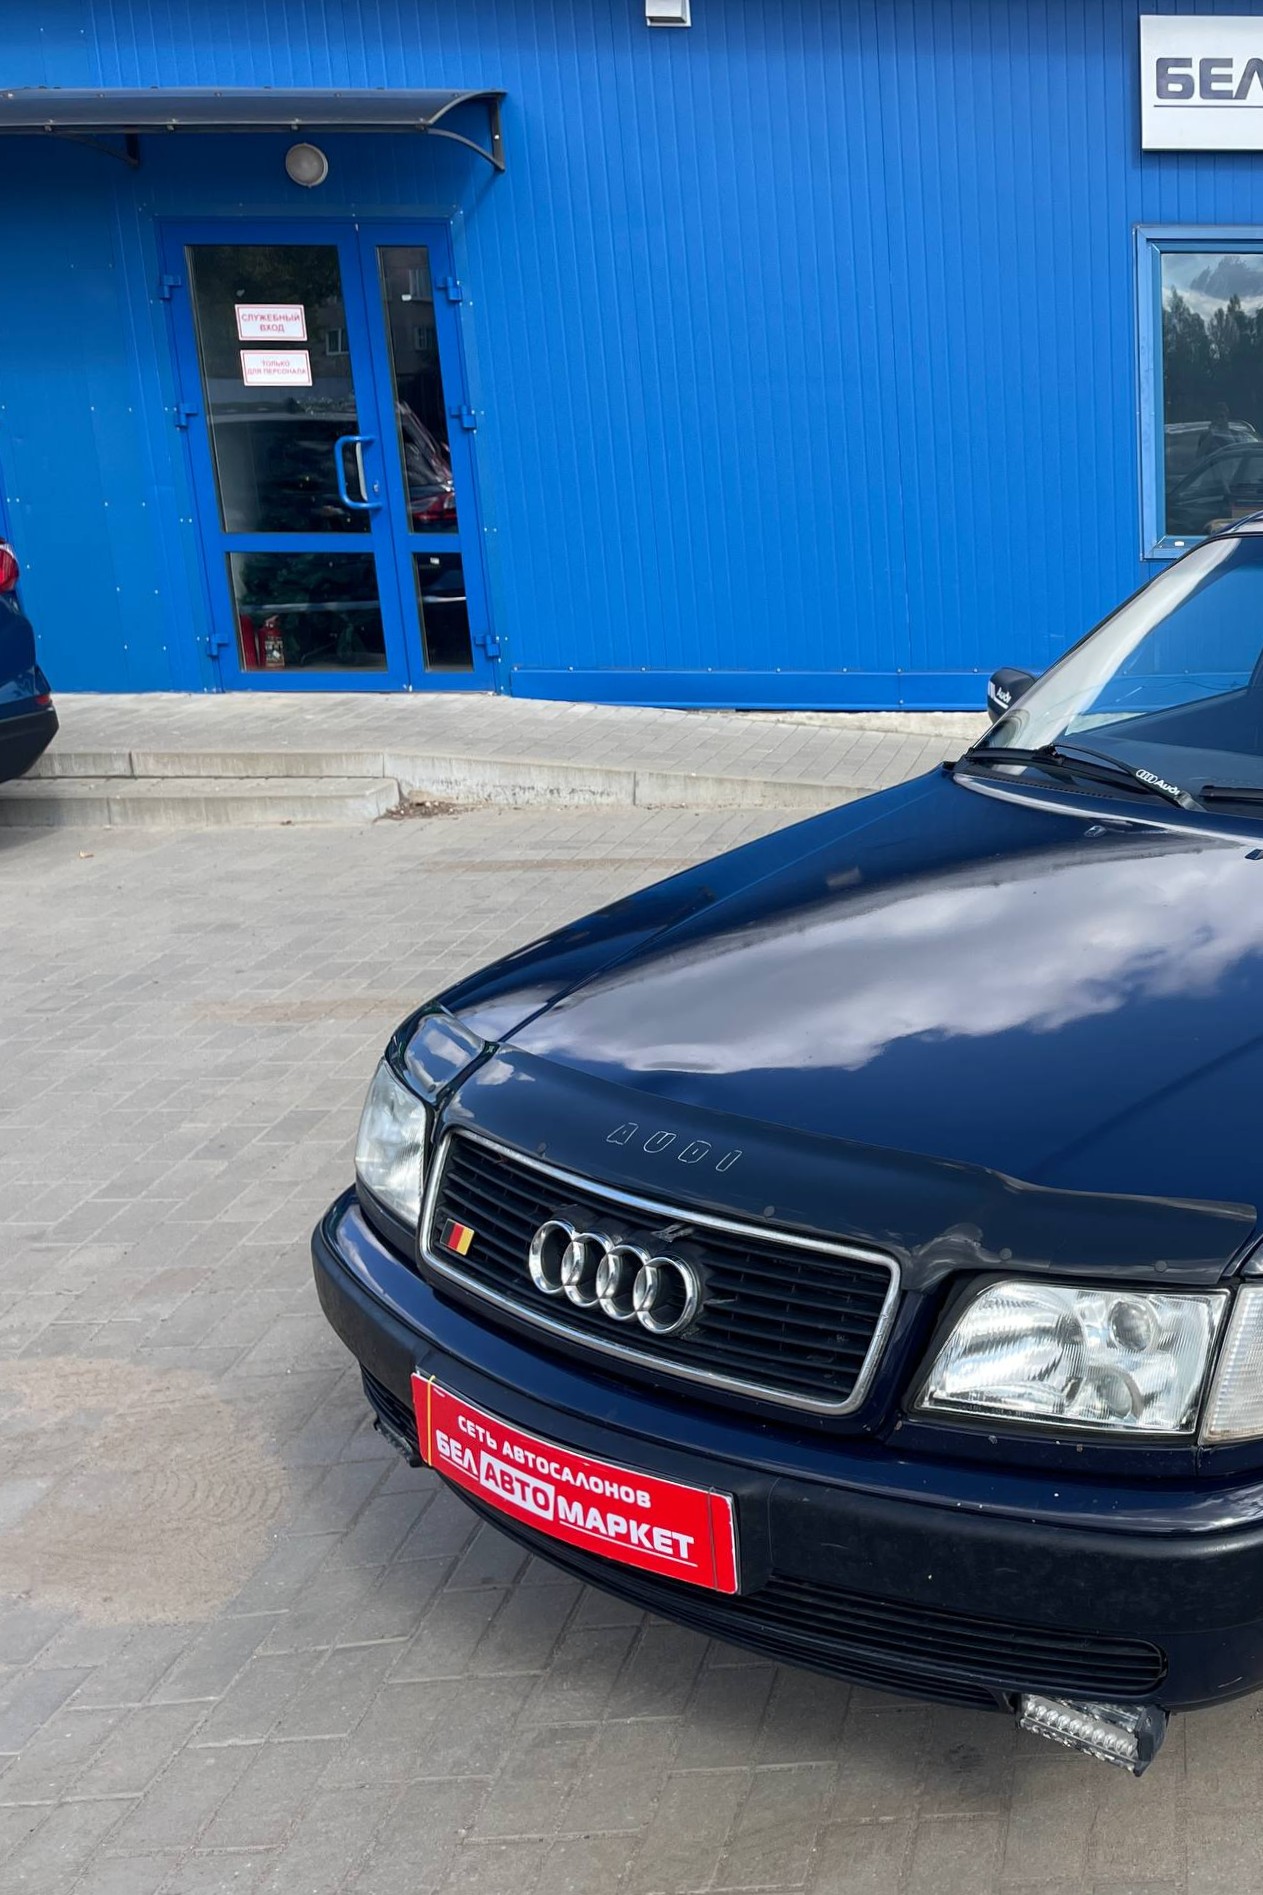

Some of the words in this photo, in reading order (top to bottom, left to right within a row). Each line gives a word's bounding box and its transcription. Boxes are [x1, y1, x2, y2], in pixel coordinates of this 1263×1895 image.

[241, 312, 300, 322] СЛУЖЕБНЫЙ
[260, 323, 285, 333] ВХОД
[1154, 779, 1181, 796] Audi
[606, 1122, 743, 1172] AUDI
[457, 1415, 498, 1451] СЕТЬ
[501, 1440, 652, 1508] АВТОСАЛОНОВ
[436, 1429, 479, 1478] БЕЛ
[484, 1464, 551, 1513] АВТО
[558, 1495, 695, 1559] МАРКЕТ
